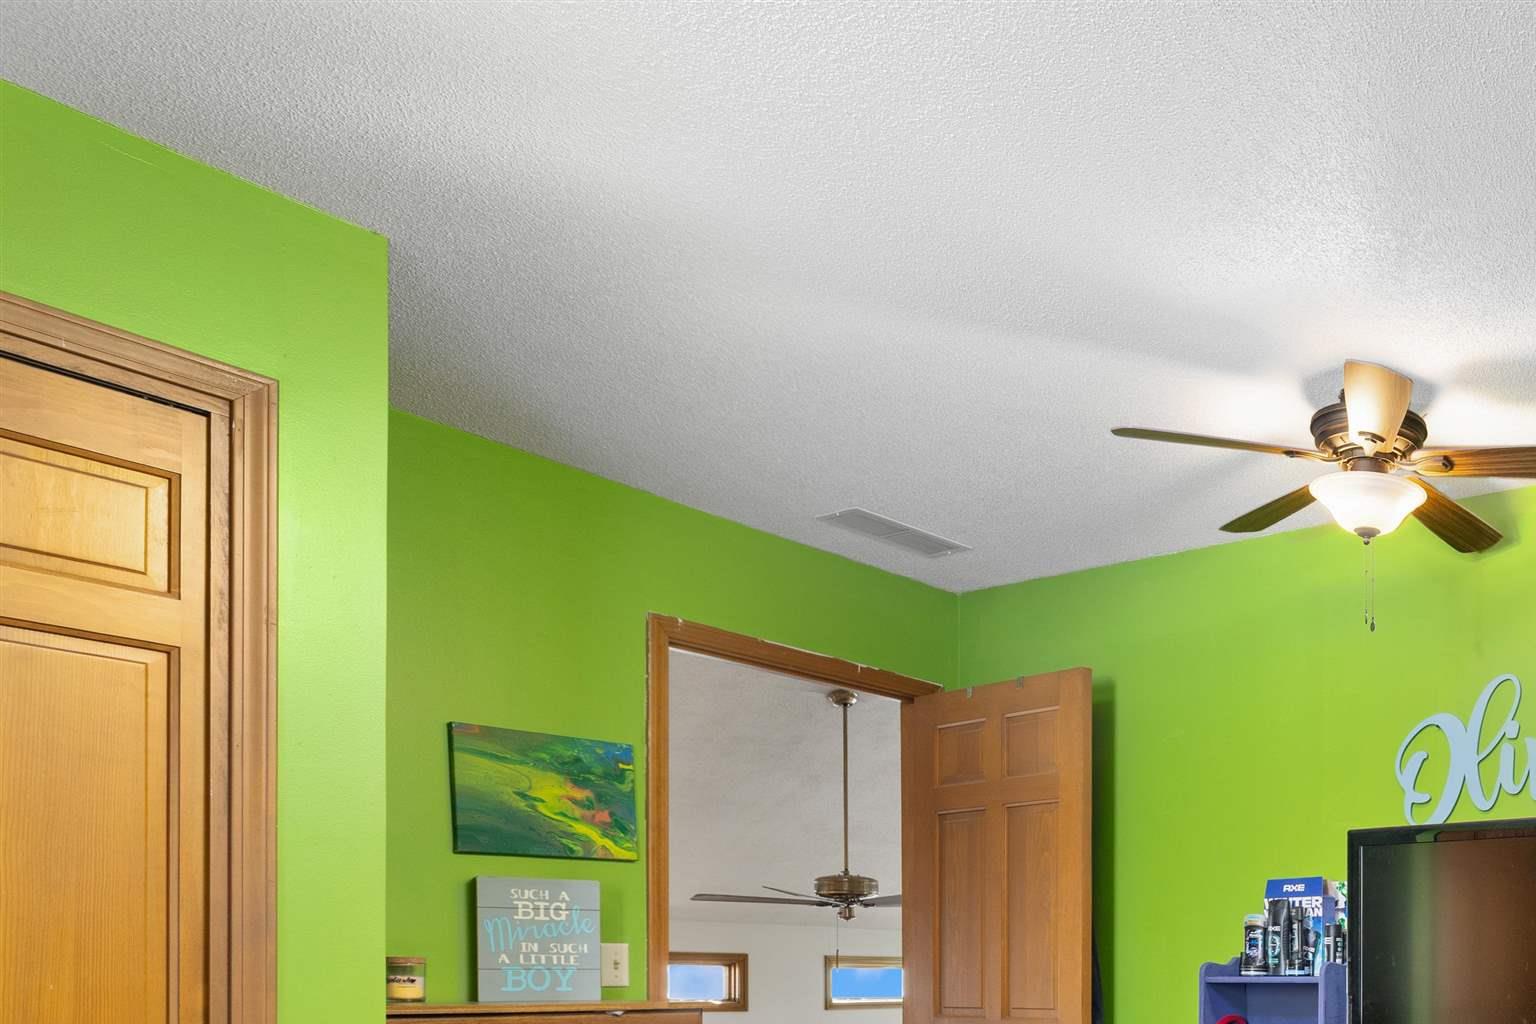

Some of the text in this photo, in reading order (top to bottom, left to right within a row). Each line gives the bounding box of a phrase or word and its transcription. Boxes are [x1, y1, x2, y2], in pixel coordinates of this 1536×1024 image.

[510, 888, 570, 901] SUCH A
[1283, 884, 1305, 892] AXE
[512, 901, 569, 920] BIG
[483, 905, 594, 953] Miracle
[520, 942, 588, 953] IN SUCH
[498, 954, 579, 965] A LITTLE
[501, 966, 576, 992] BOY
